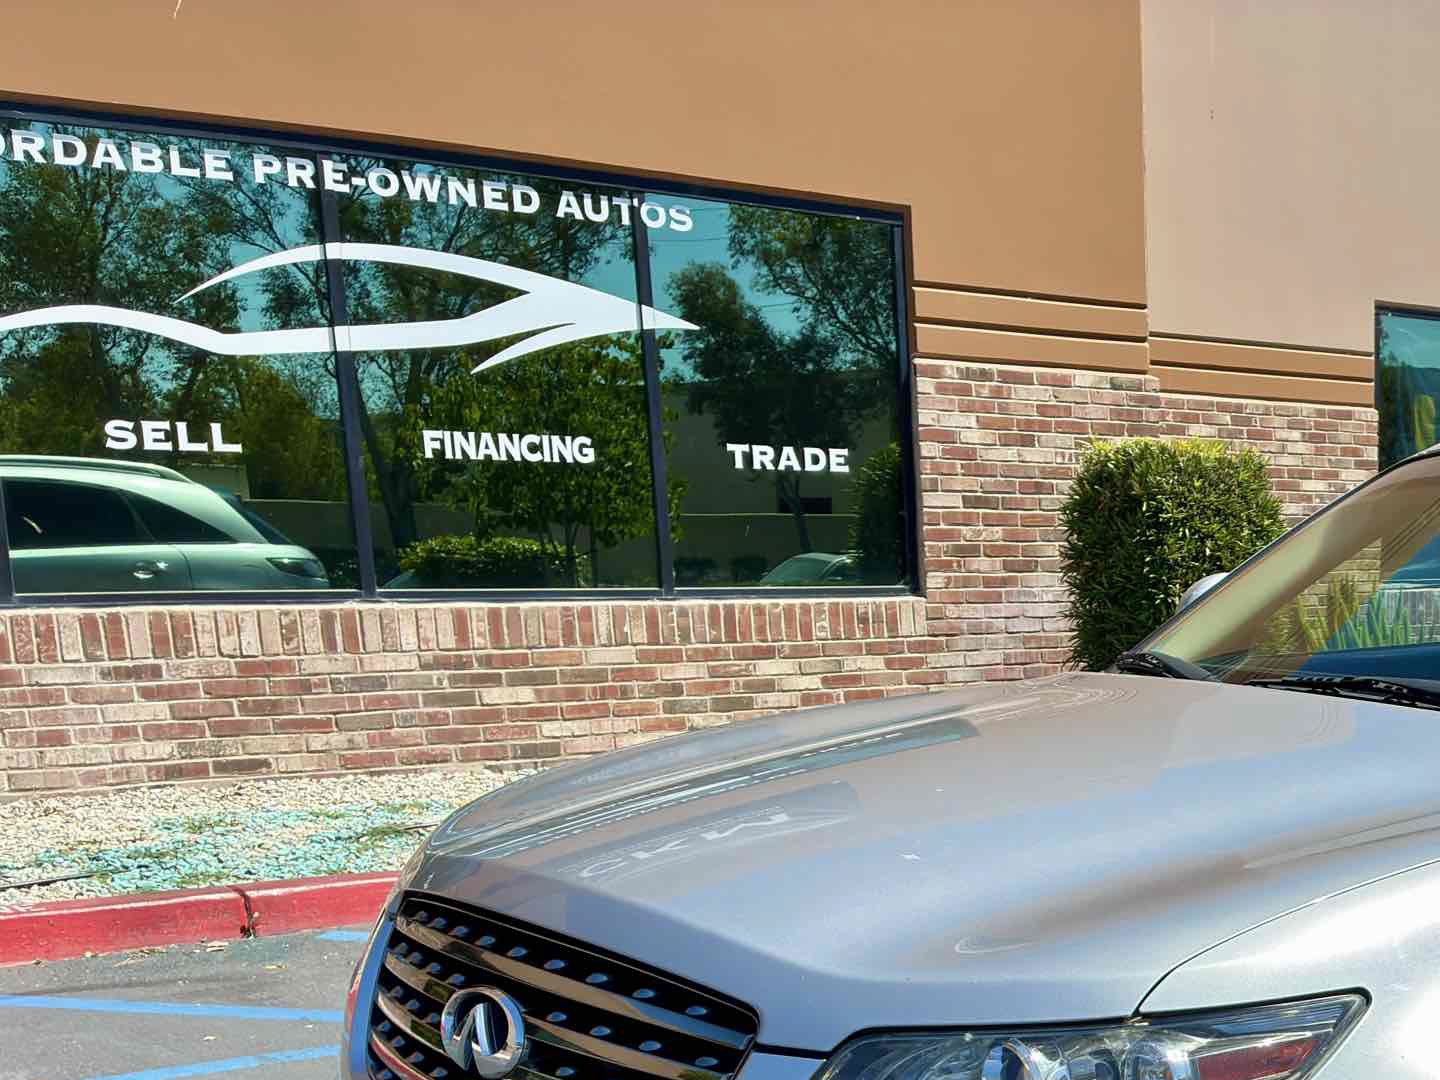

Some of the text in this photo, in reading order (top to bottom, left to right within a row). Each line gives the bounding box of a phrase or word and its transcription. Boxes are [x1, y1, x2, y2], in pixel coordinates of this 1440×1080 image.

[0, 129, 694, 232] RDABLE PRE-OWNED AUTOS
[104, 419, 243, 453] SELL
[422, 430, 595, 463] FINANCING
[726, 443, 851, 473] TRADE
